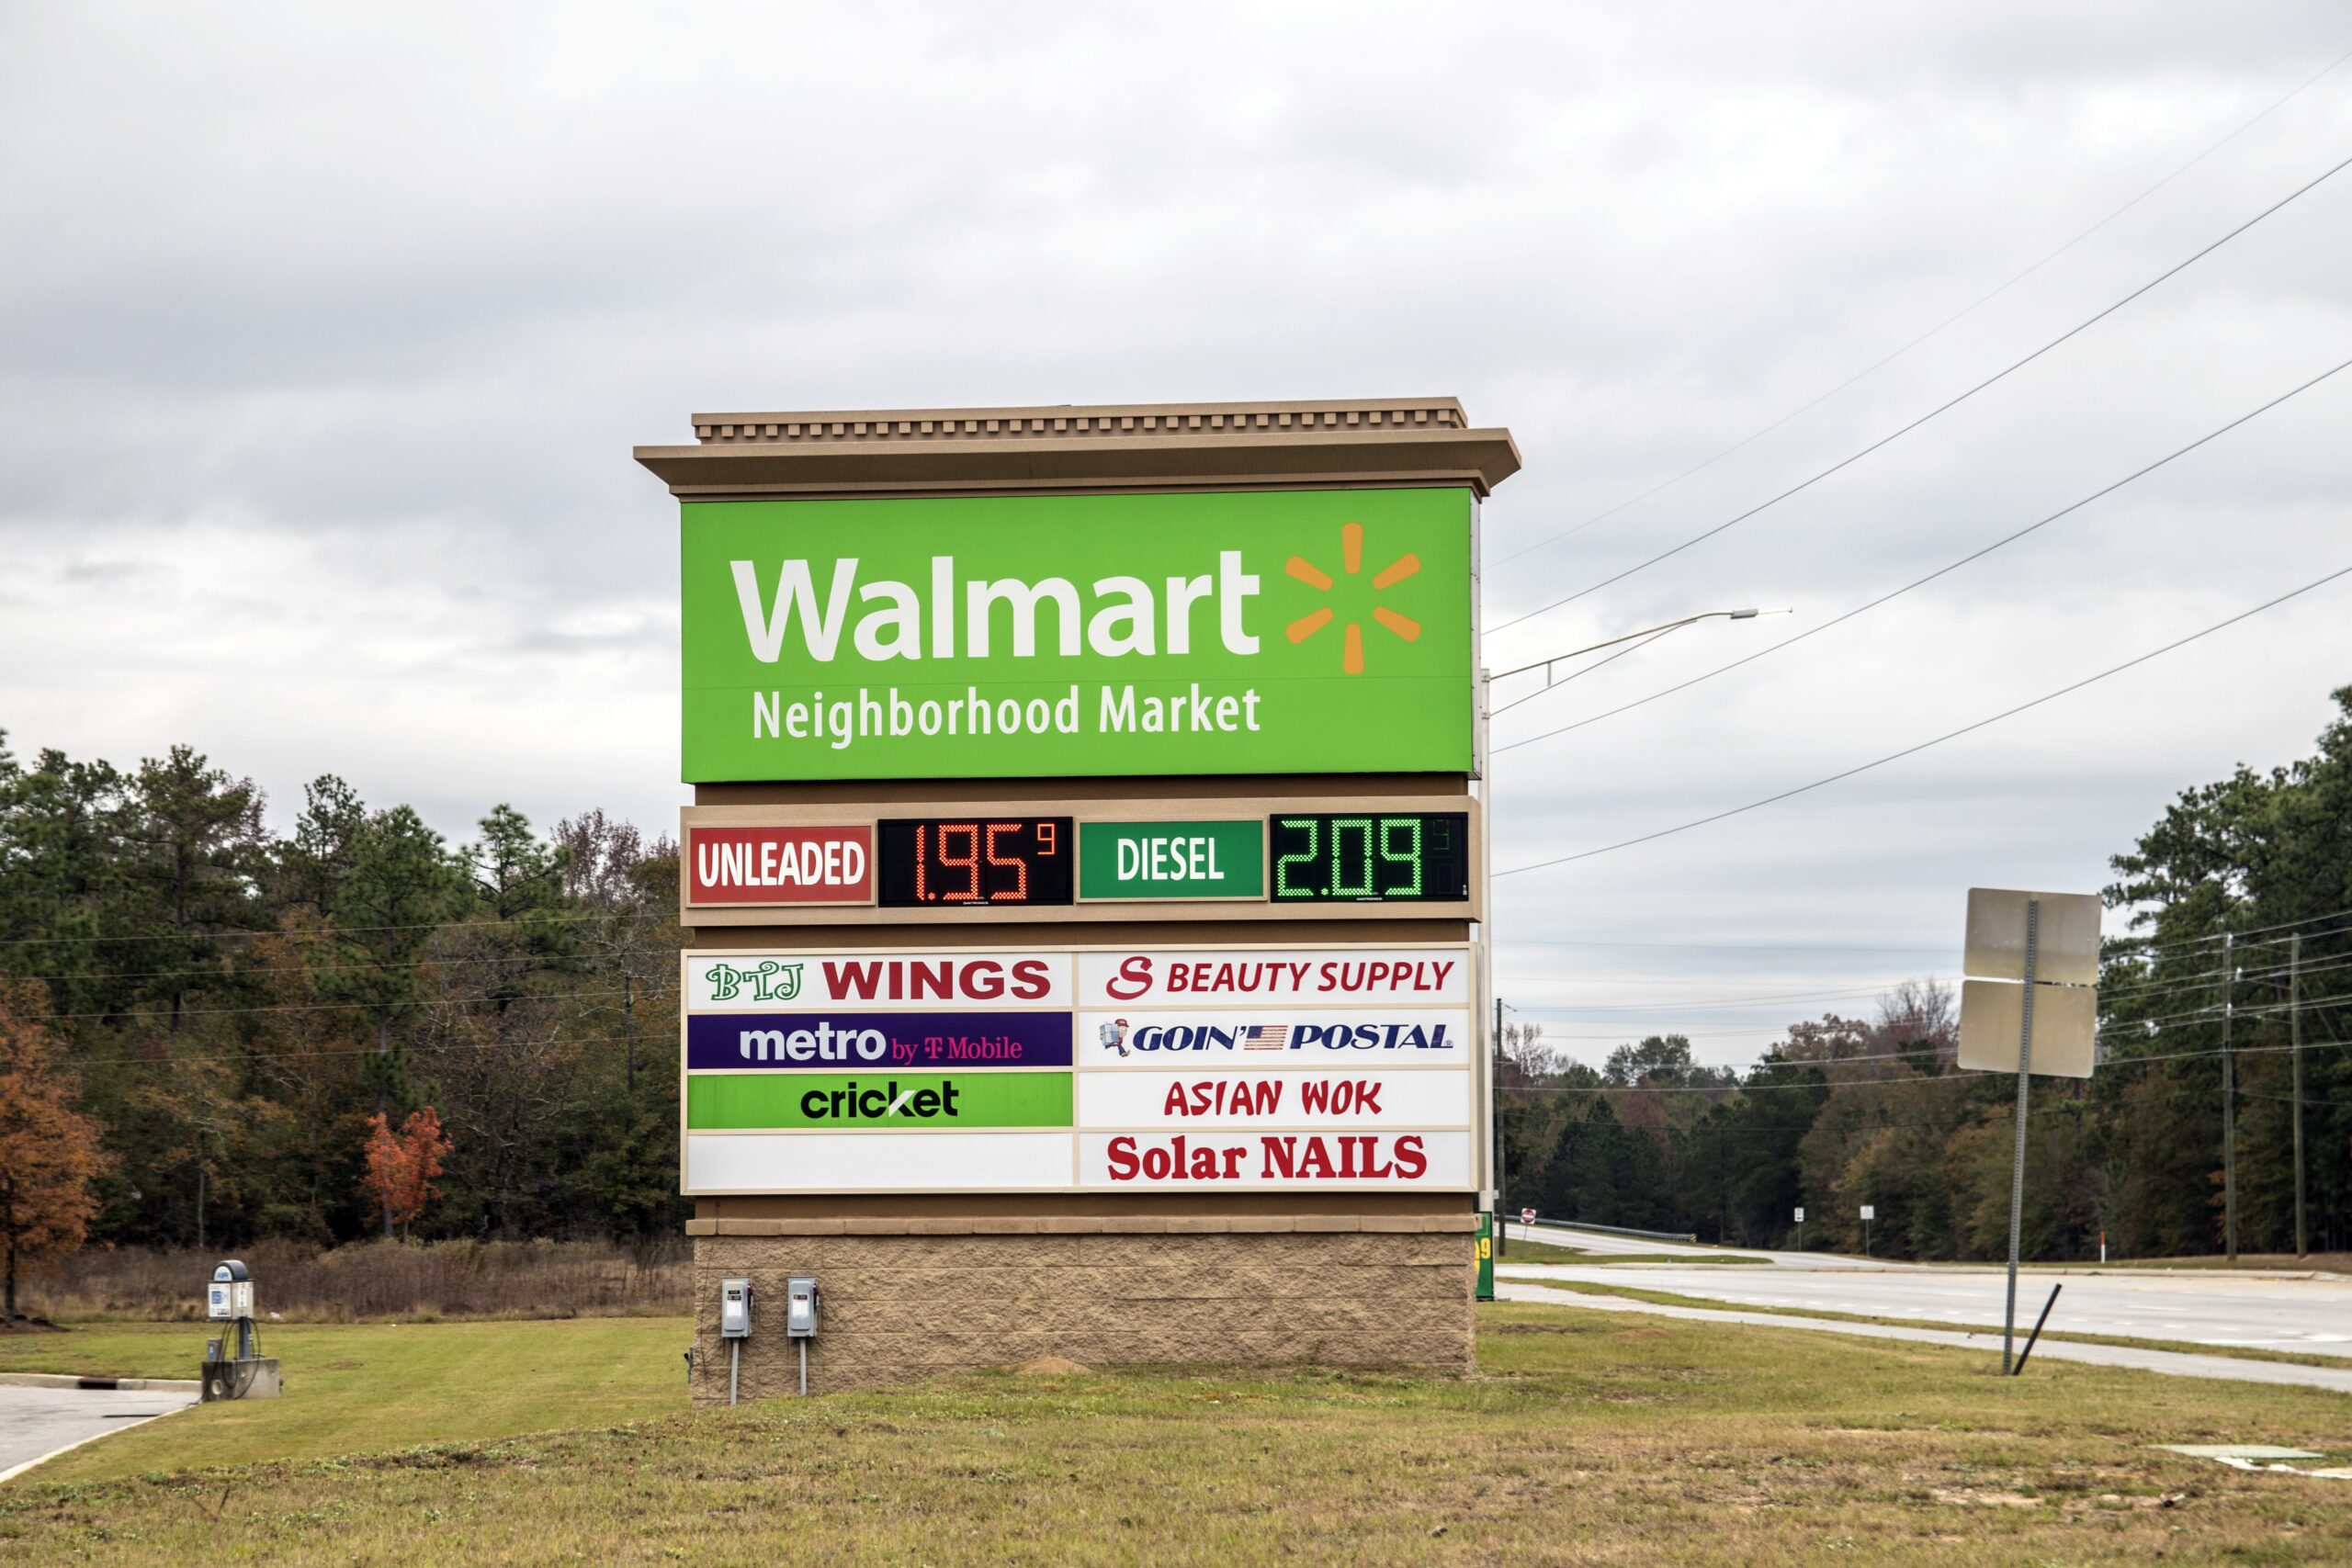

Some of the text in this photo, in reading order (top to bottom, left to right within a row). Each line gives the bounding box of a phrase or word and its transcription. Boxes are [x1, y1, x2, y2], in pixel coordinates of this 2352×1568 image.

[730, 550, 1260, 662] Walmart
[753, 682, 1261, 749] Neighborhood Market
[698, 840, 865, 887] UNLEADED
[916, 823, 1056, 901] 1.95 9
[1117, 837, 1225, 881] DIESEL
[1277, 818, 1421, 897] 2.09
[706, 960, 1051, 1002] BTJ WINGS
[1106, 956, 1454, 1000] S BEAUTY SUPPLY
[740, 1021, 887, 1061] metro
[891, 1038, 919, 1066] by
[1133, 1023, 1453, 1052] GOIN' POSTAL
[800, 1080, 959, 1119] cricket
[1164, 1079, 1383, 1117] ASIAN WOK
[1107, 1135, 1427, 1180] Solar NAILS
